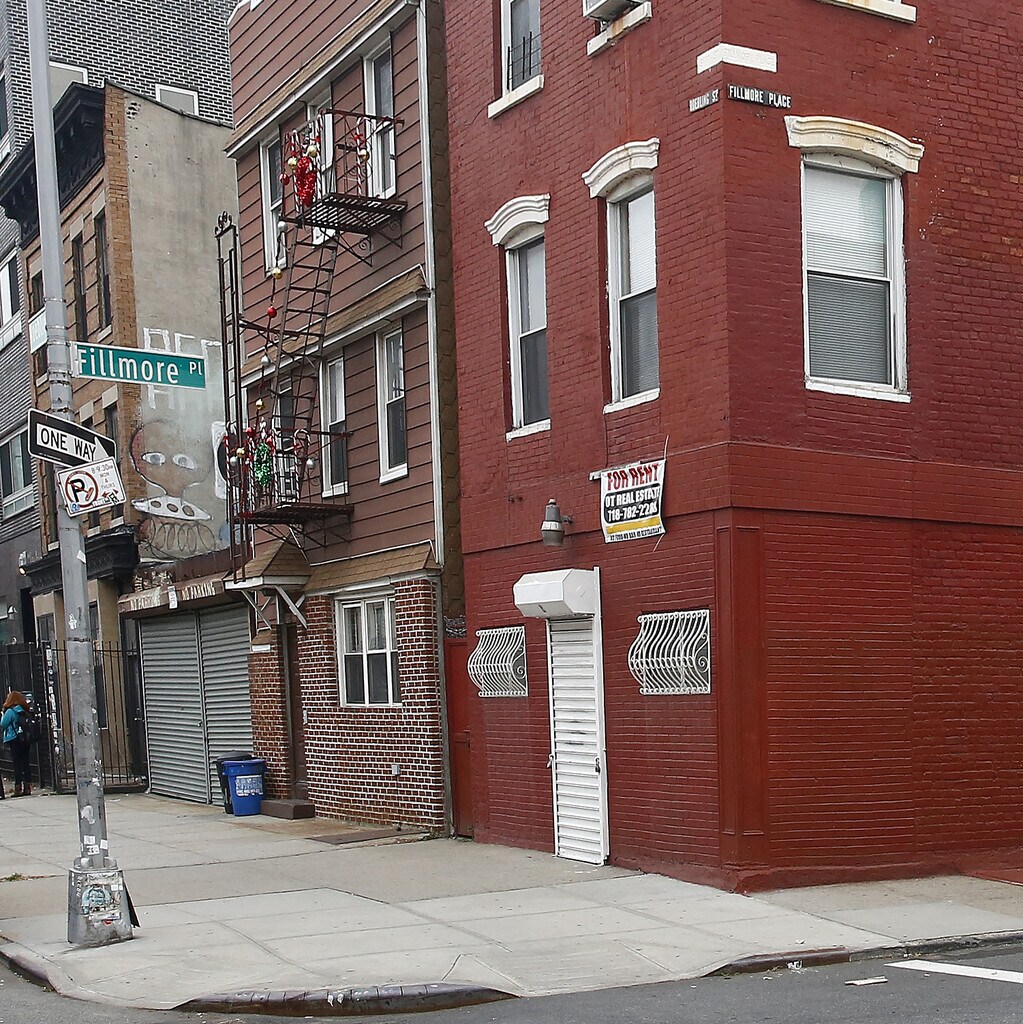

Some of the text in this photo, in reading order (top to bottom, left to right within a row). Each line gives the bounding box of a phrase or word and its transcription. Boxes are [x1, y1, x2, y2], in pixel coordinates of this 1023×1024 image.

[729, 85, 792, 108] FILLMORE PLACE
[77, 347, 203, 384] Fillmore Pl
[40, 427, 97, 461] ONE WAY
[607, 463, 659, 491] FOR RENT
[616, 491, 635, 506] REAL
